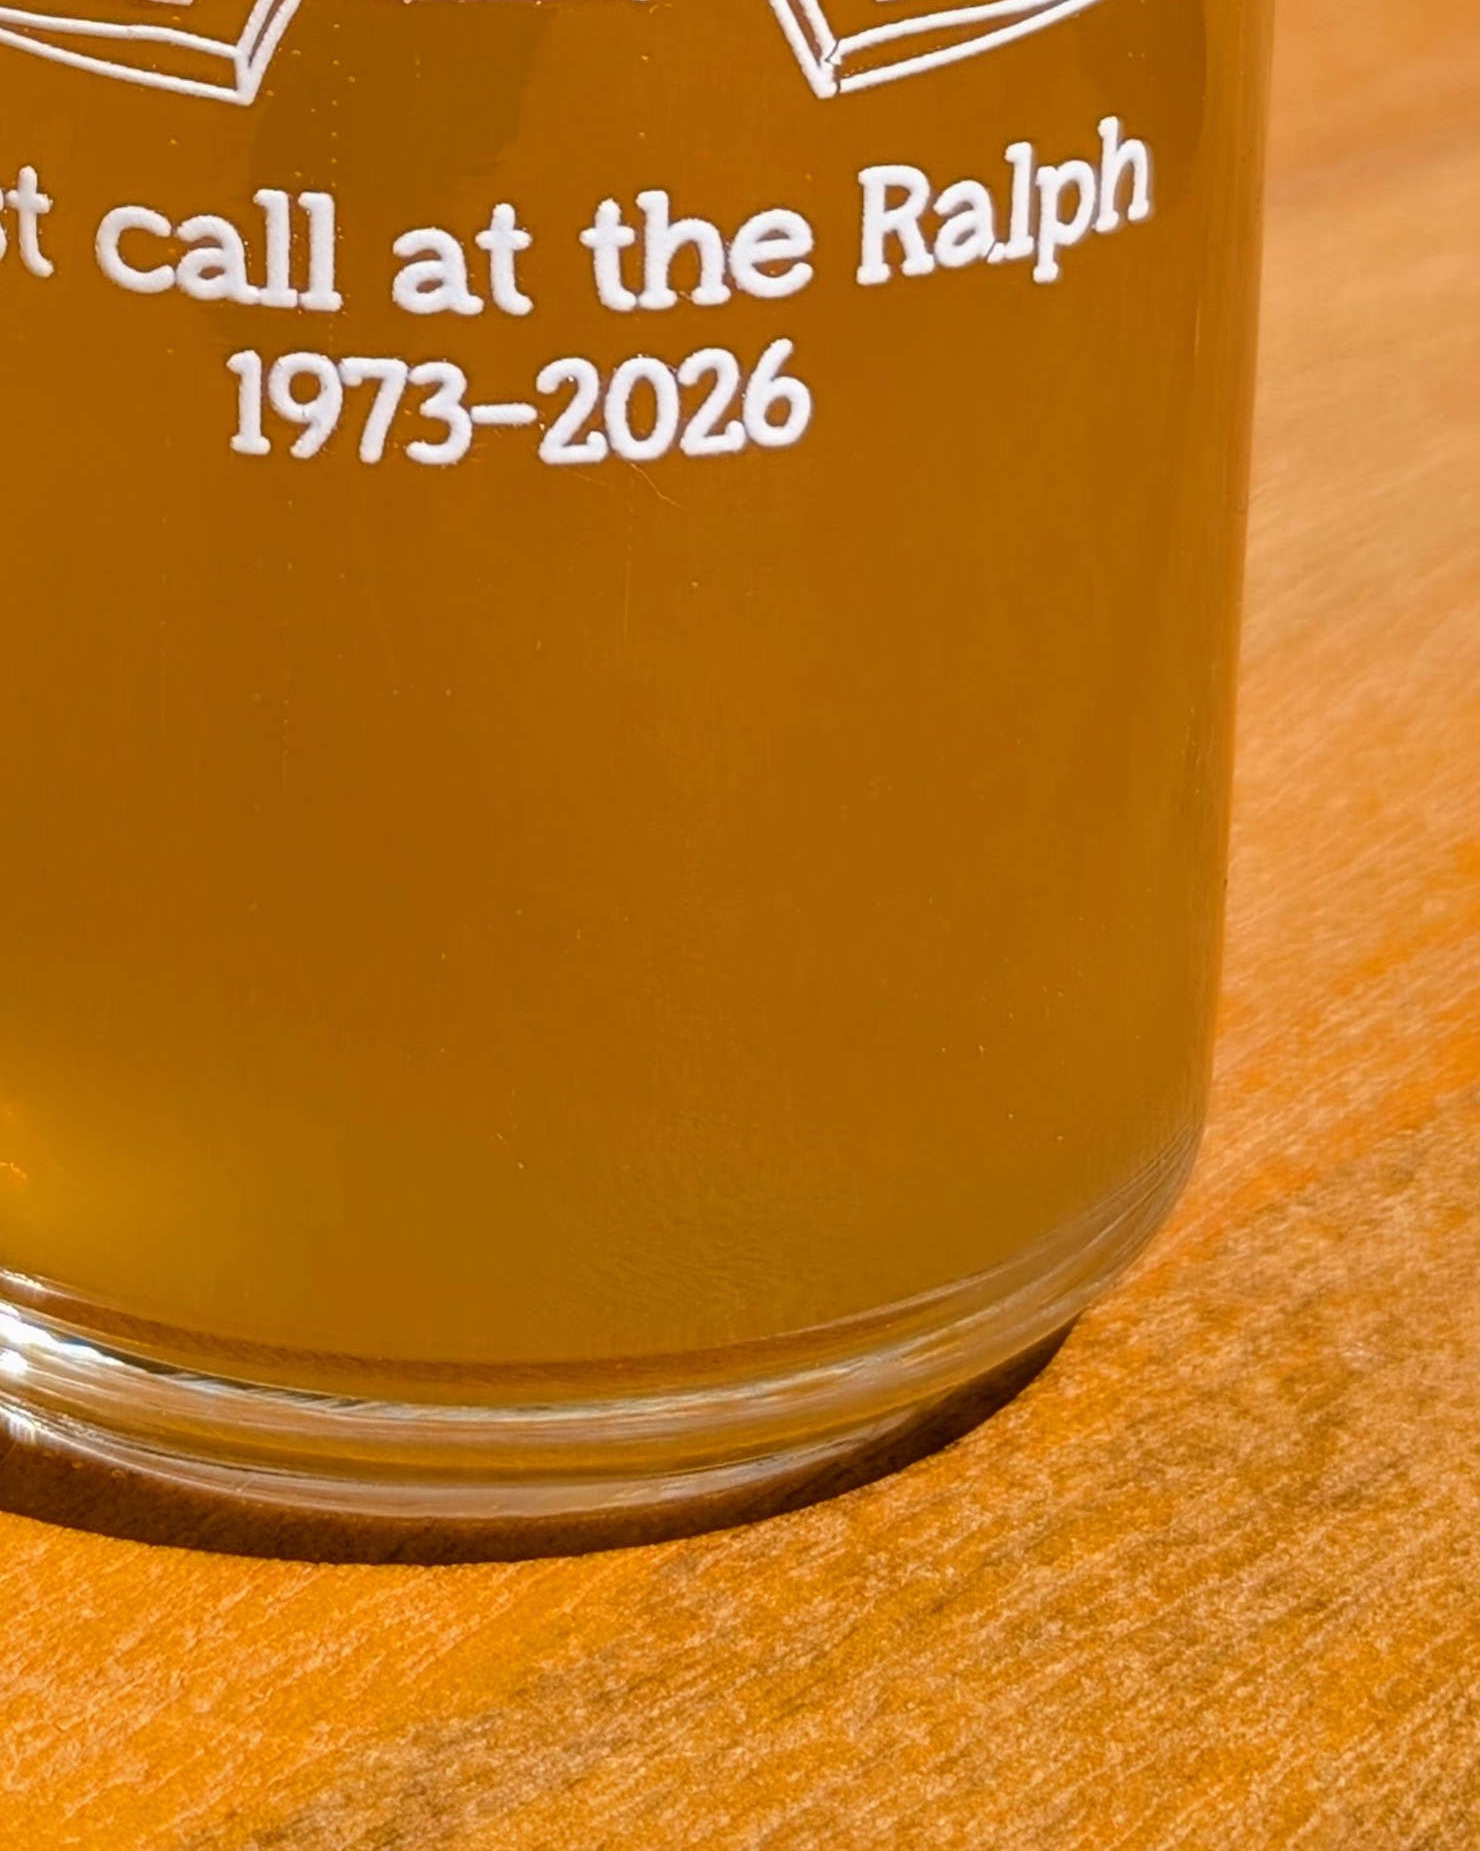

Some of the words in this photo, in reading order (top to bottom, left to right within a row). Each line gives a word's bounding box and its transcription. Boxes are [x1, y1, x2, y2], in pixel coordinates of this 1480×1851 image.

[95, 187, 344, 313] call
[391, 201, 534, 316] at
[578, 188, 815, 312] the
[855, 115, 1153, 286] Ralph
